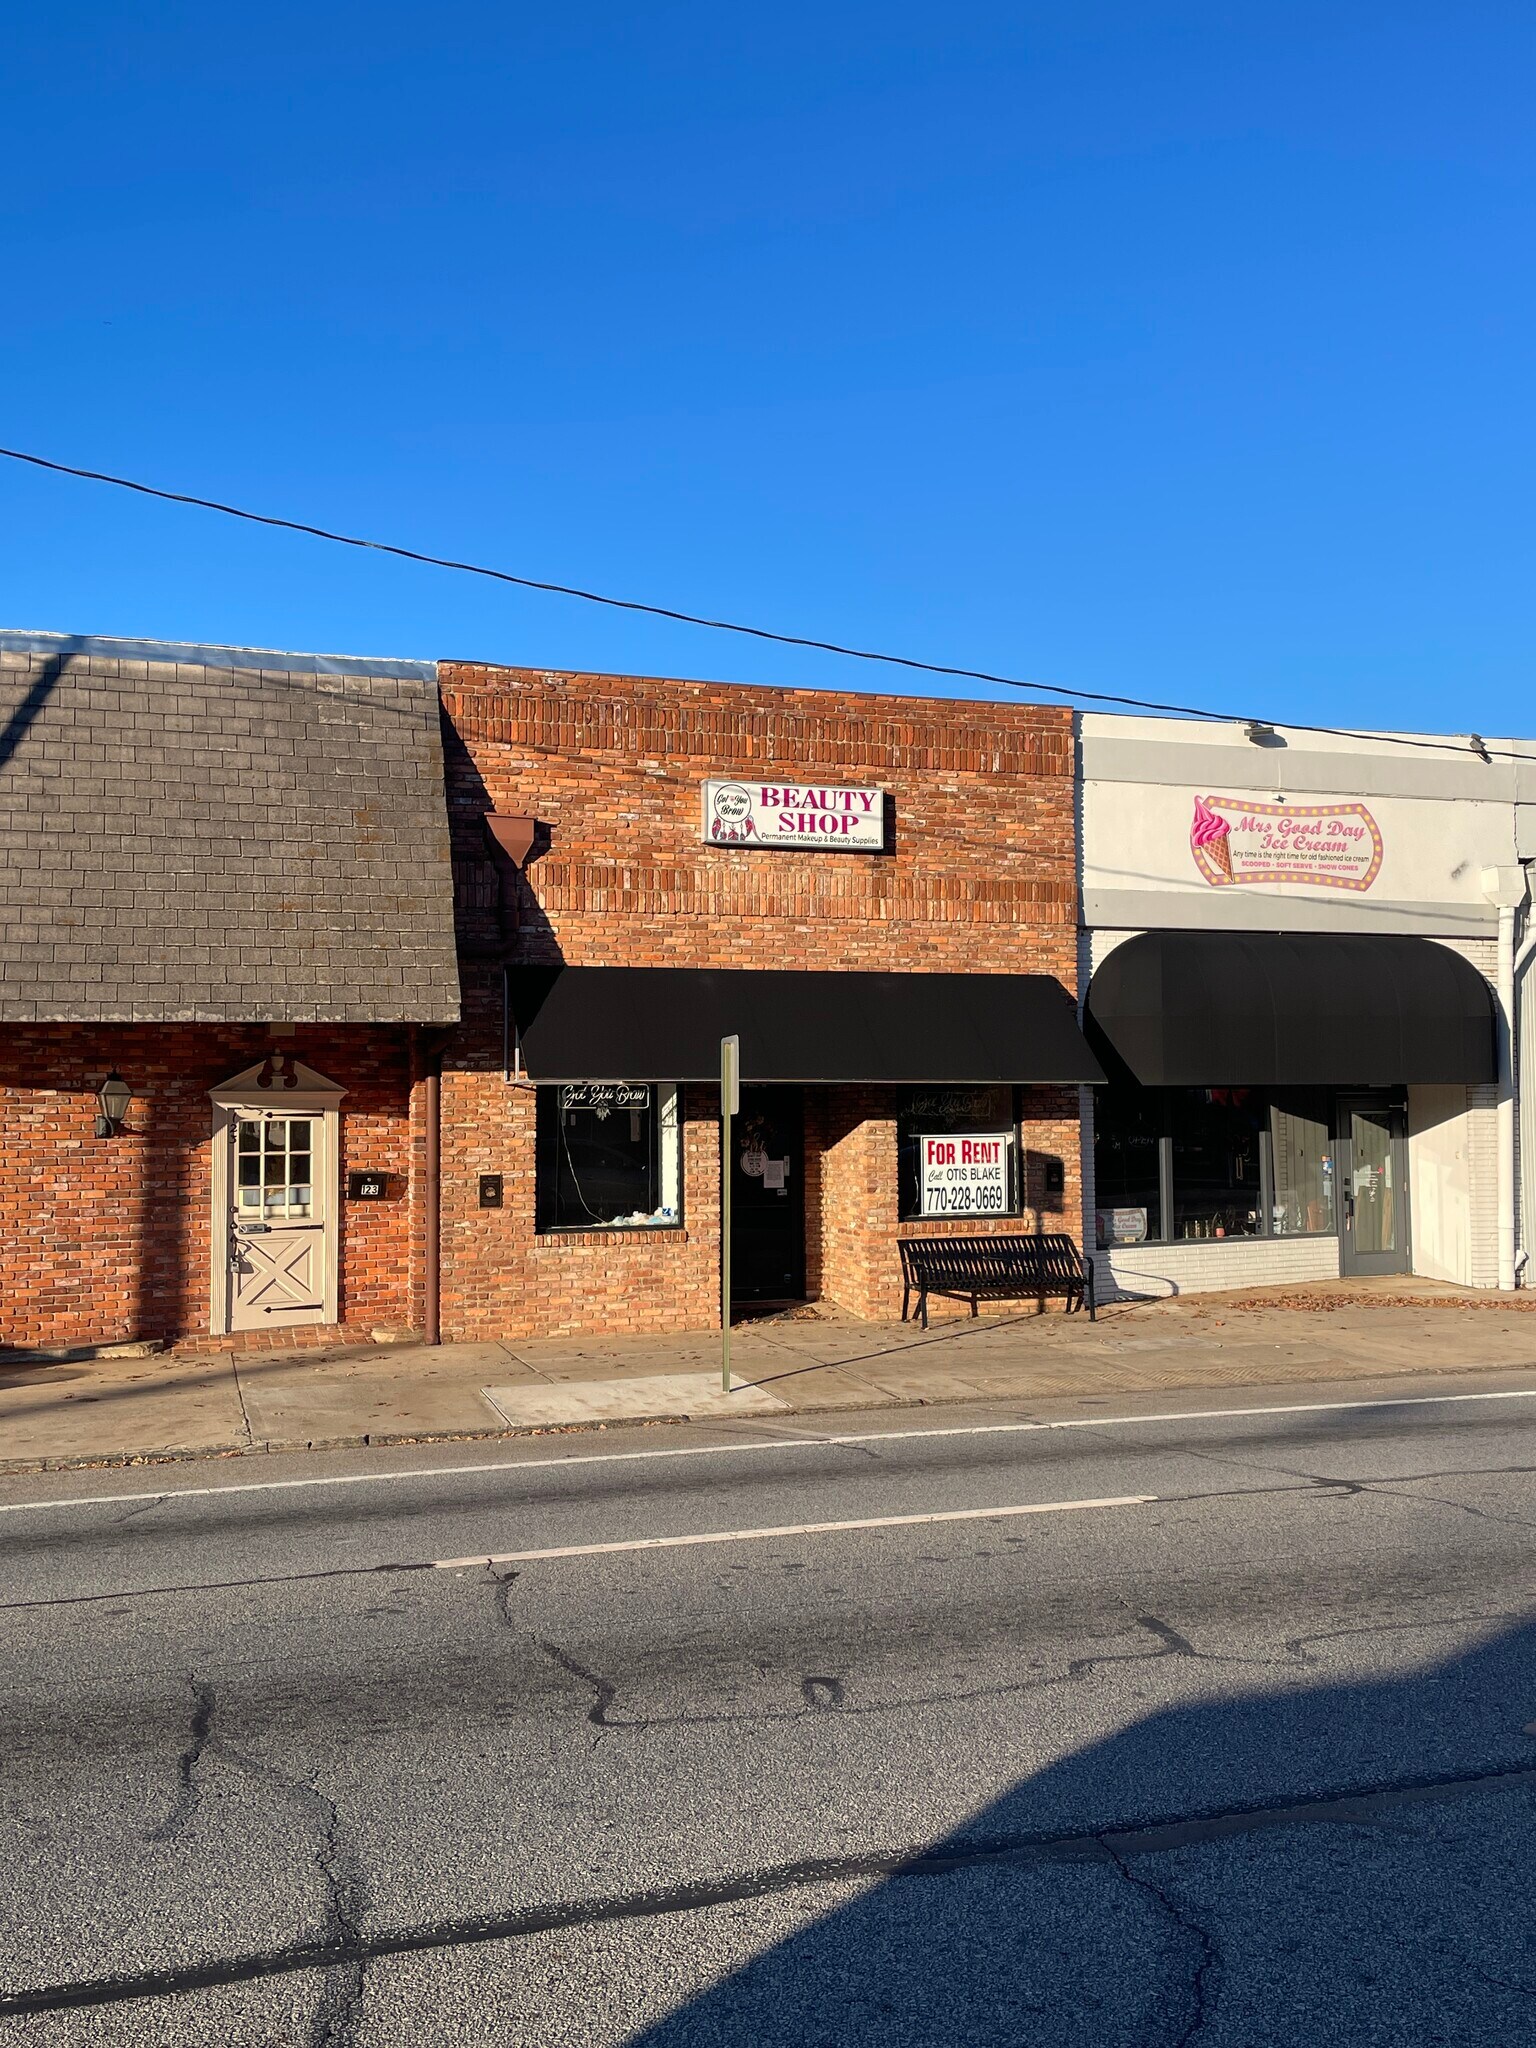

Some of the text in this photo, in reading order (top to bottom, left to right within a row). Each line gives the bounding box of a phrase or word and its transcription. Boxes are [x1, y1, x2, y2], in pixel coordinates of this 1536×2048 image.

[717, 794, 748, 806] Got You
[760, 787, 877, 812] BEAUTY
[721, 804, 744, 815] Brow
[778, 811, 859, 835] SHOP
[1234, 816, 1366, 841] Mrs Good Day
[762, 832, 796, 841] Permanent
[798, 834, 822, 843] Makeup
[830, 835, 851, 844] Beauty
[852, 837, 878, 845] Supplies
[1260, 834, 1348, 852] Ice Cream
[1233, 850, 1243, 859] Any
[1244, 850, 1257, 858] time
[1273, 851, 1286, 861] right
[1300, 852, 1308, 860] for
[1318, 853, 1343, 861] fashioned
[562, 1084, 645, 1108] Got You Brow
[927, 1139, 1000, 1165] FOR RENT
[928, 1167, 1001, 1182] Call OTIS BLAKE
[362, 1185, 378, 1195] 123
[927, 1185, 1002, 1211] 770-228-0669
